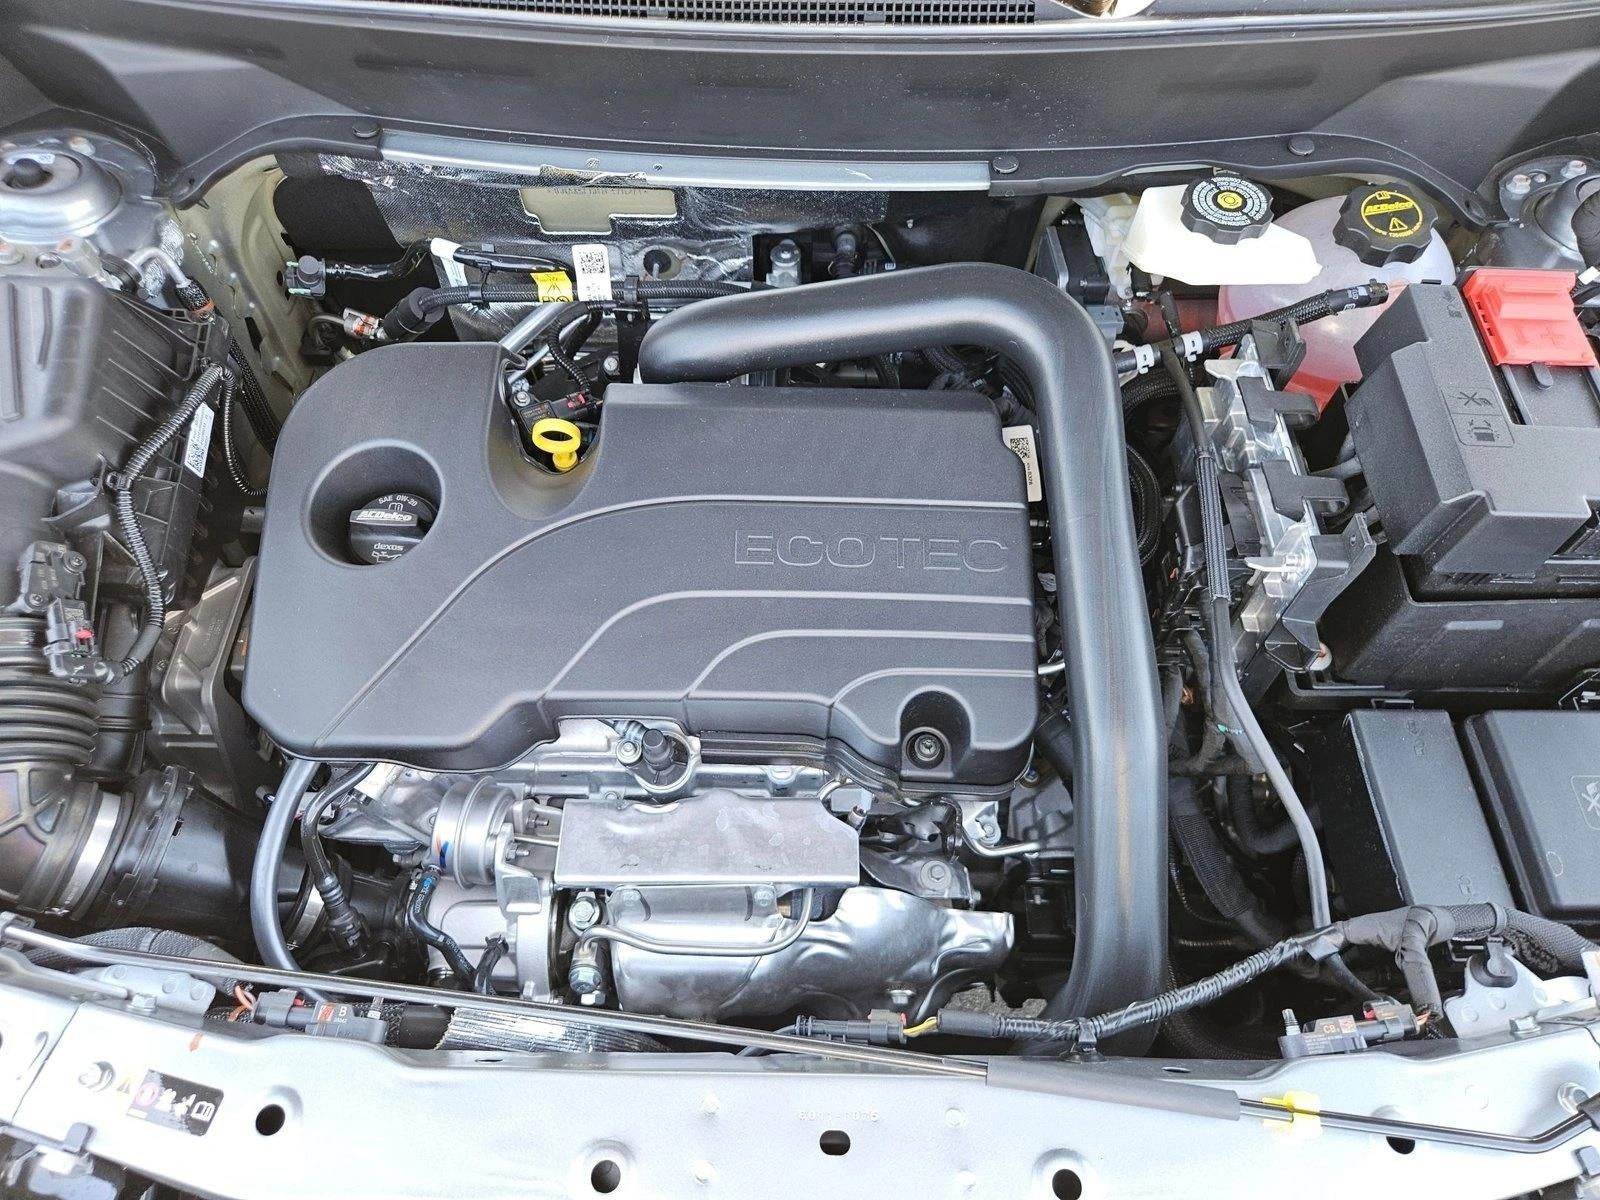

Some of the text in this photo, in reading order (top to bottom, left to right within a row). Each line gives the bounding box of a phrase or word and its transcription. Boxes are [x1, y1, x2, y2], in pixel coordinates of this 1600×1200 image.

[378, 494, 418, 507] SAE 0W-20
[356, 510, 413, 521] ACDelco
[374, 542, 404, 551] dexos
[735, 529, 1008, 572] ECOTEC
